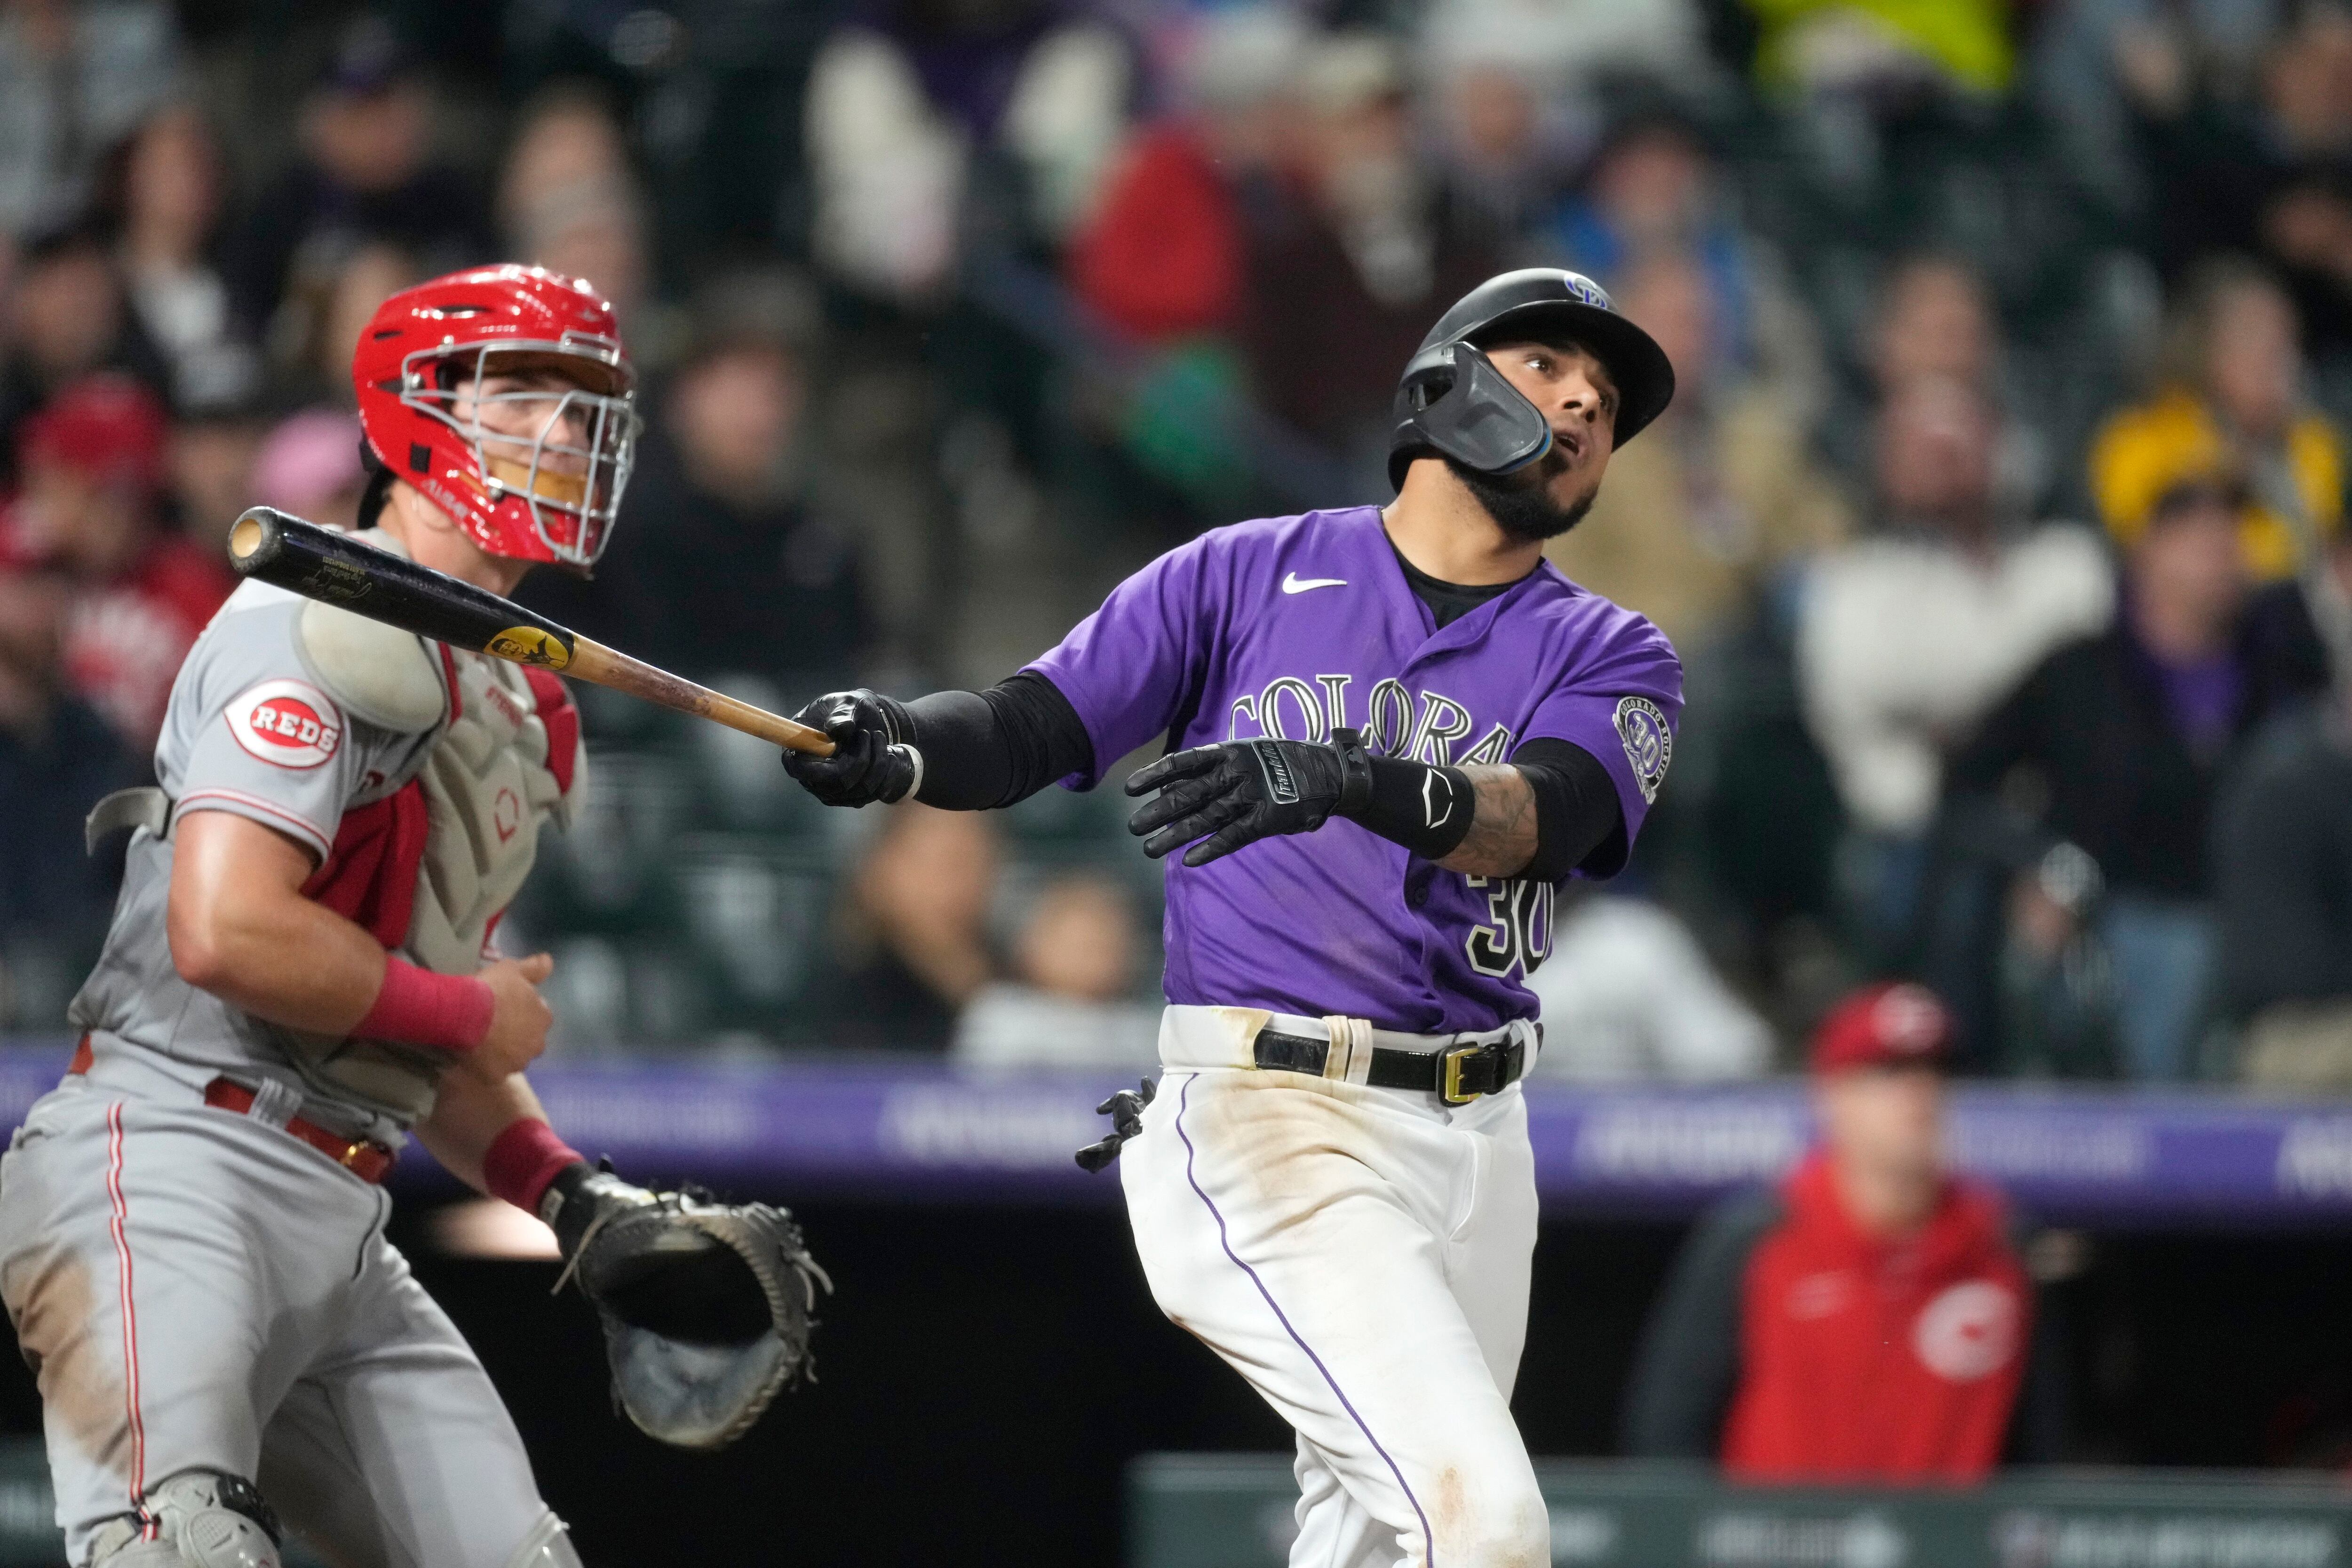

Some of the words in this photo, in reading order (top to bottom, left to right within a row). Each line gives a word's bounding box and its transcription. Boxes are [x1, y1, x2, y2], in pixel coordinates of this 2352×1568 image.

[252, 706, 338, 753] REDS
[1620, 699, 1661, 722] COLORADO
[1655, 726, 1669, 781] ROCKIES
[1261, 742, 1296, 798] Franklin
[1465, 874, 1554, 980] 30
